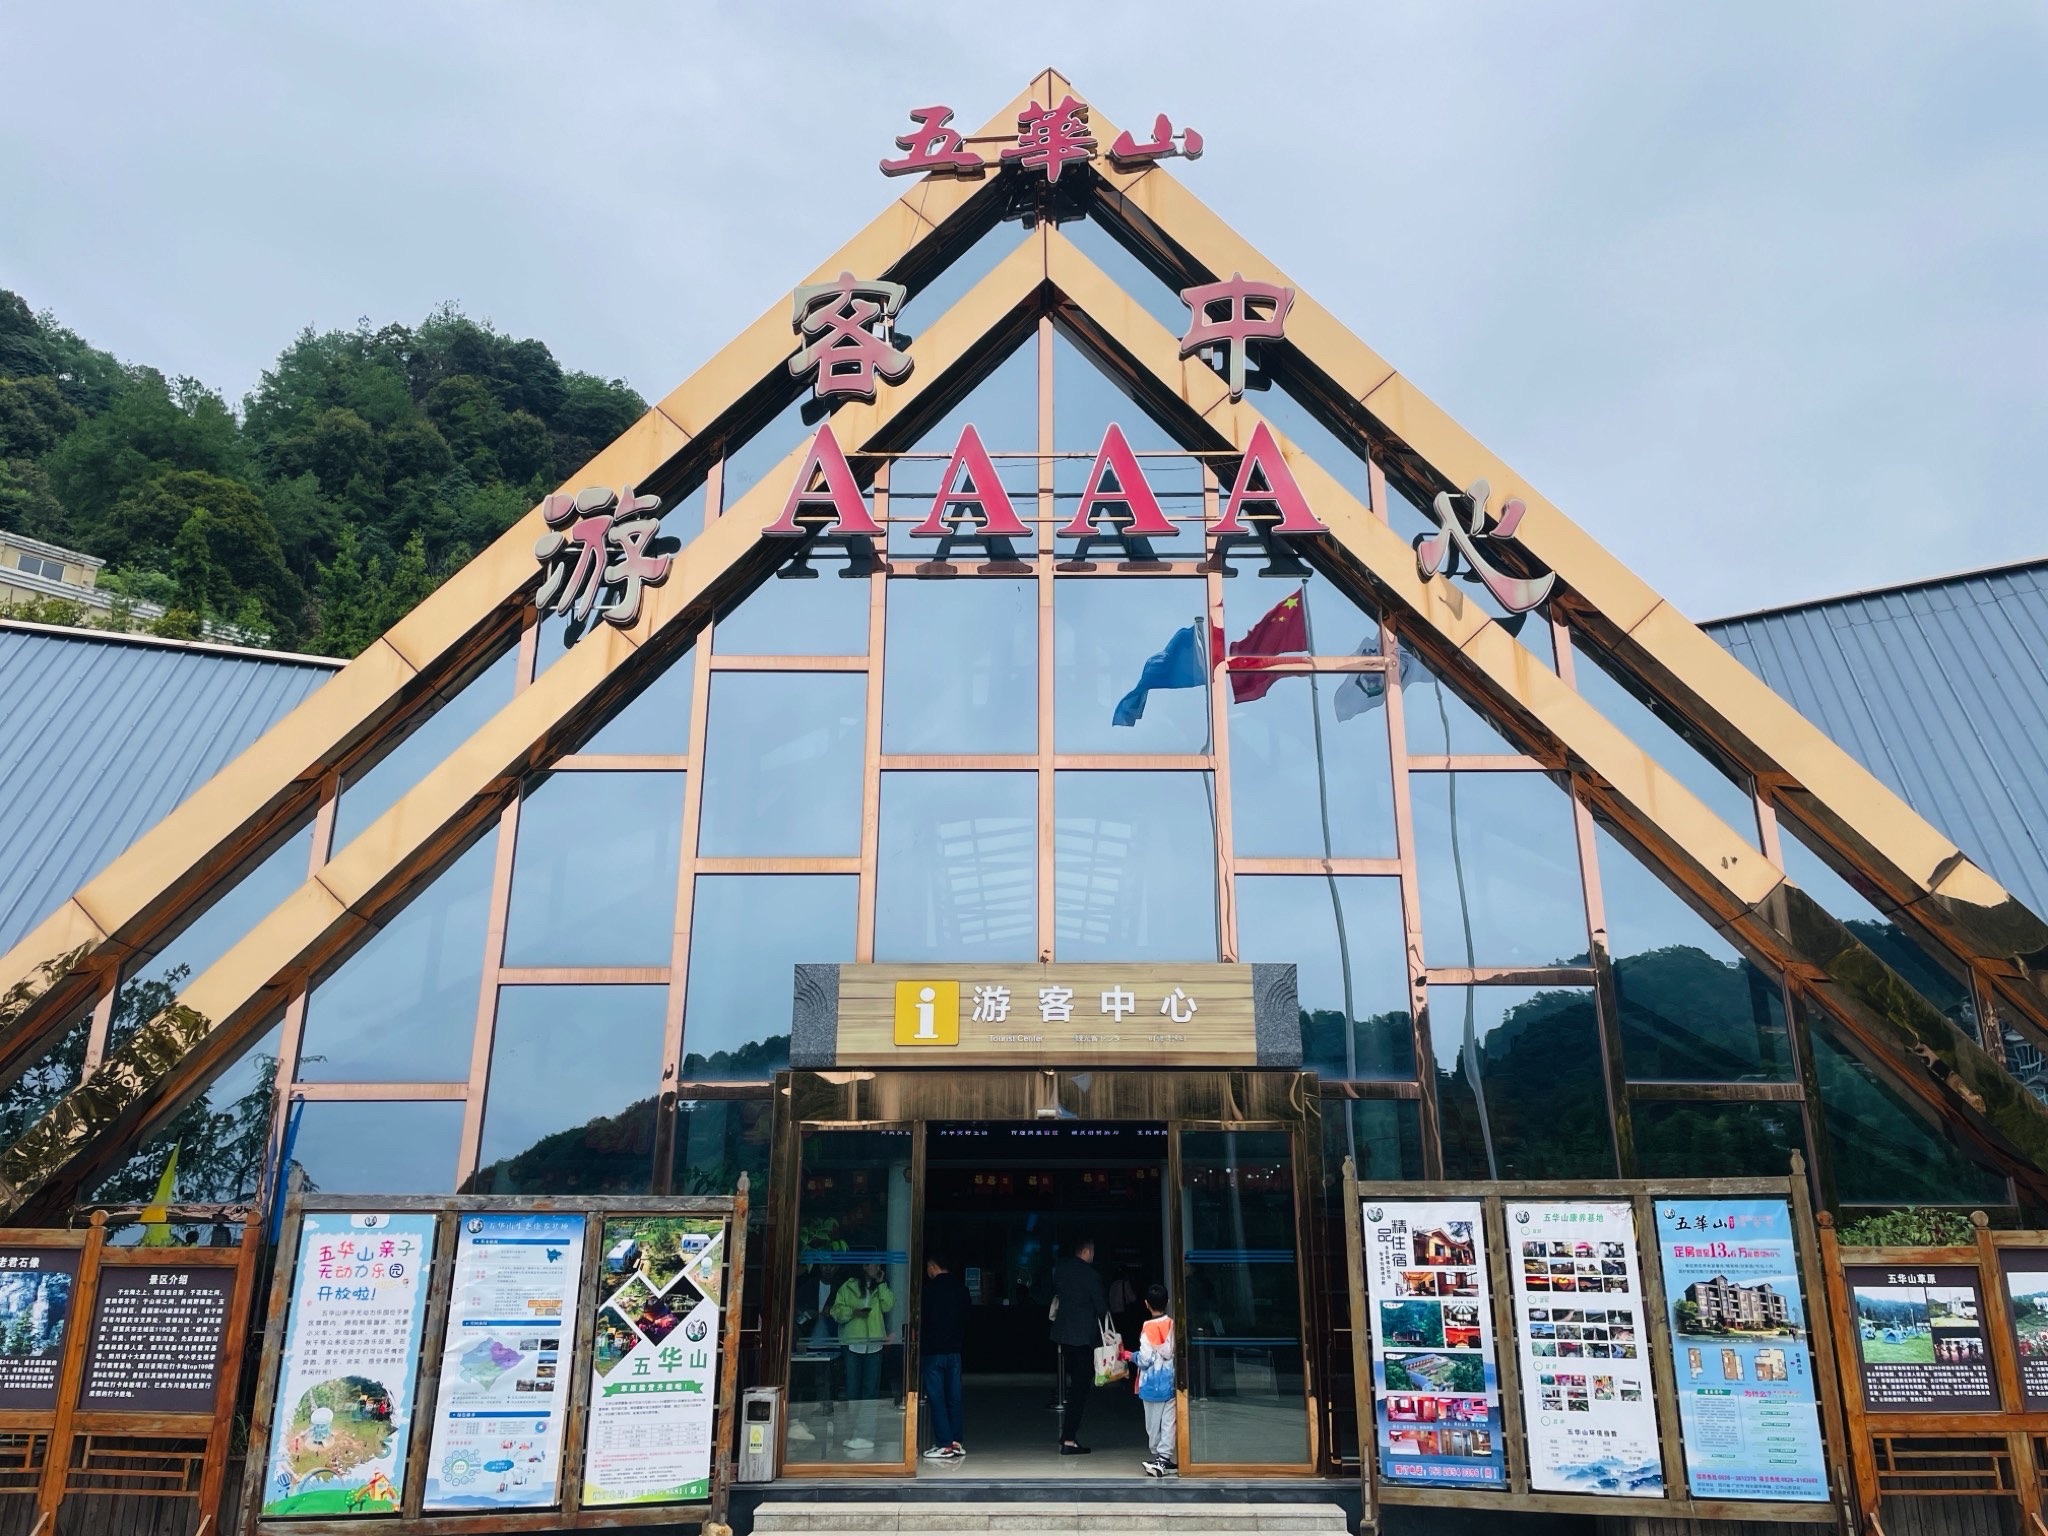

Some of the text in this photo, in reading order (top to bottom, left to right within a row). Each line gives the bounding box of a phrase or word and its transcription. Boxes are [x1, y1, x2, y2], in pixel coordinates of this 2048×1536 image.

[879, 95, 1205, 183] 五華山
[535, 272, 1556, 632] 游 客 中 心
[972, 985, 1198, 1023] 游客中心
[989, 1034, 1044, 1042] Tourist Center
[1544, 1213, 1604, 1223] 五华山康养基地
[1675, 1215, 1728, 1232] 五華山
[319, 1240, 415, 1262] 五华山亲子
[149, 1274, 189, 1285] 景区介绍
[319, 1263, 404, 1279] 无动力乐园
[1888, 1273, 1936, 1284] 五华山草原
[632, 1347, 707, 1376] 五华山
